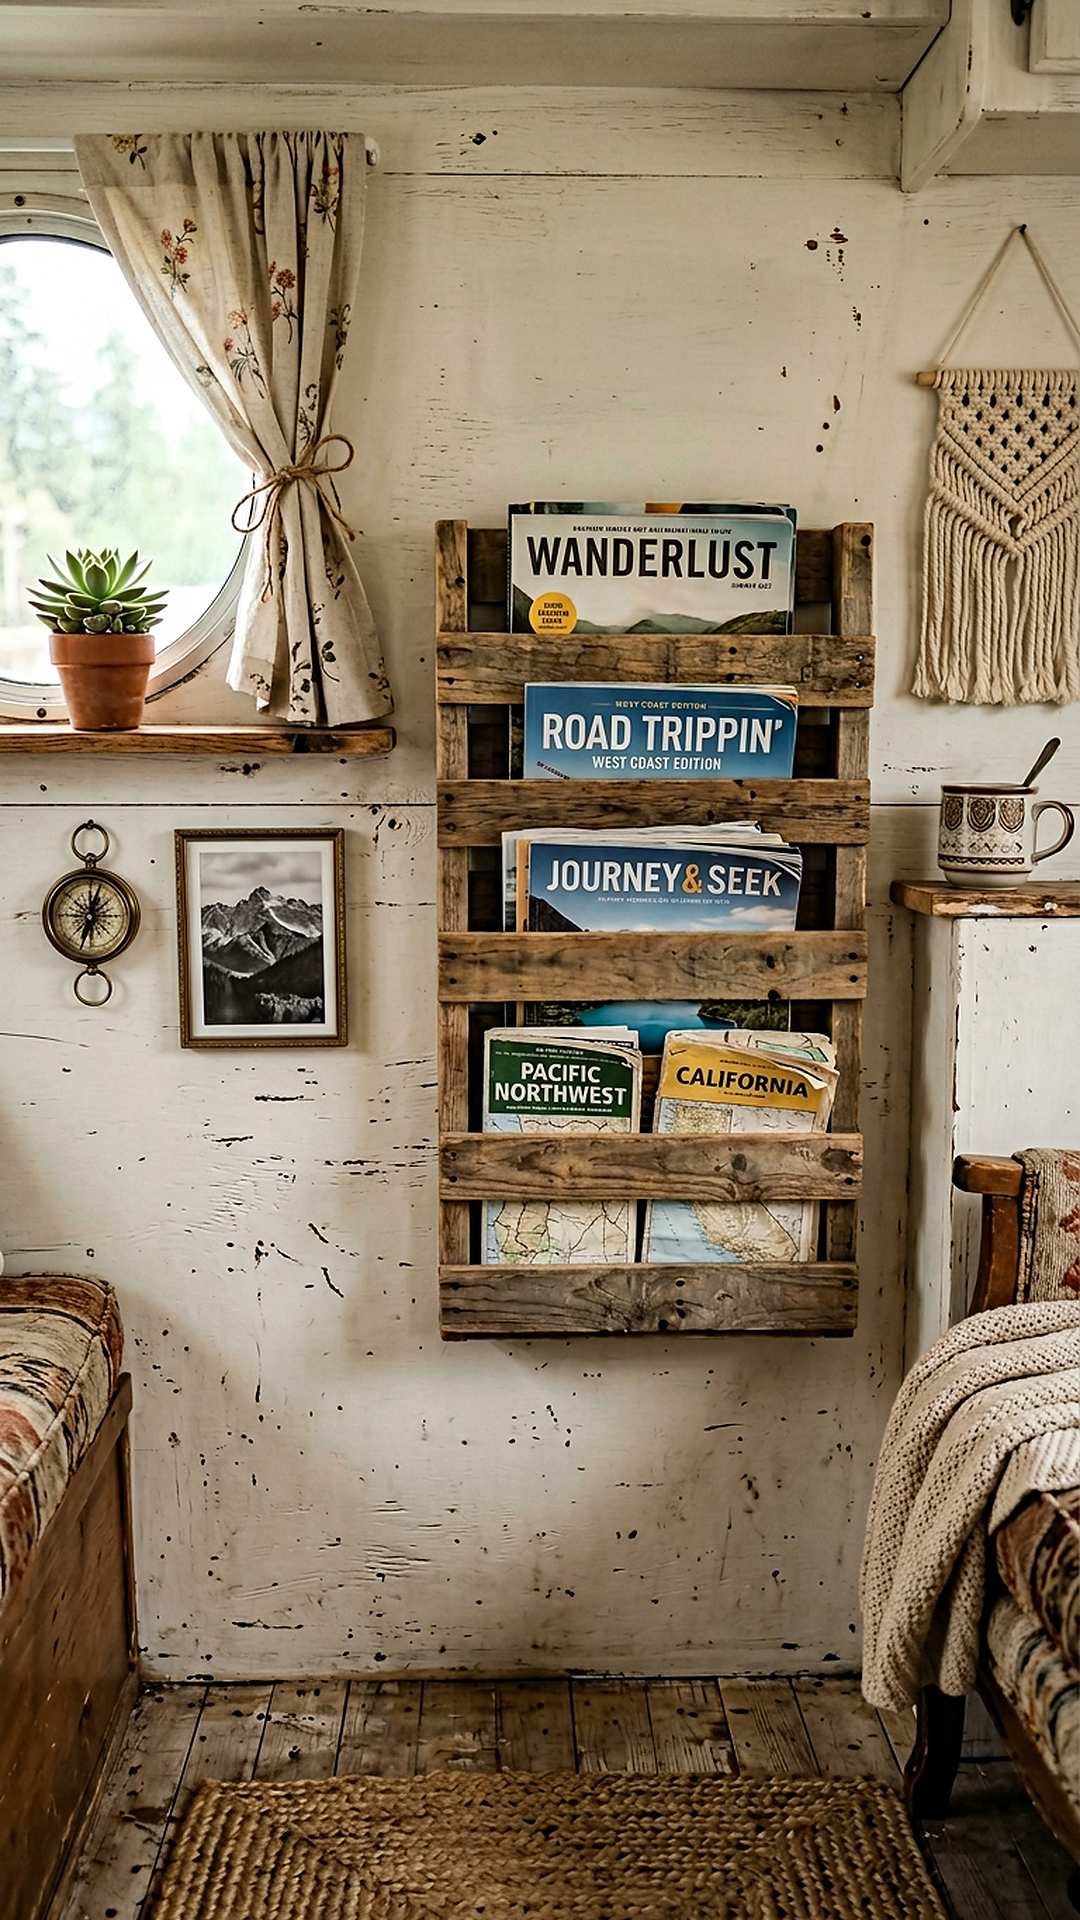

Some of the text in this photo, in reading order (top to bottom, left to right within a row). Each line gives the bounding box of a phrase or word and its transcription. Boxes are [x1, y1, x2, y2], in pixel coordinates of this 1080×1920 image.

[526, 536, 777, 579] WANDERLUST
[542, 713, 783, 754] ROAD TRIPPIN'
[592, 755, 721, 771] WEST COAST EDITION
[546, 859, 682, 894] JOURNEY
[707, 863, 783, 897] SEEK
[521, 1061, 601, 1083] PACIFIC
[676, 1066, 809, 1099] CALIFORNIA
[495, 1082, 627, 1106] NORTHWEST
